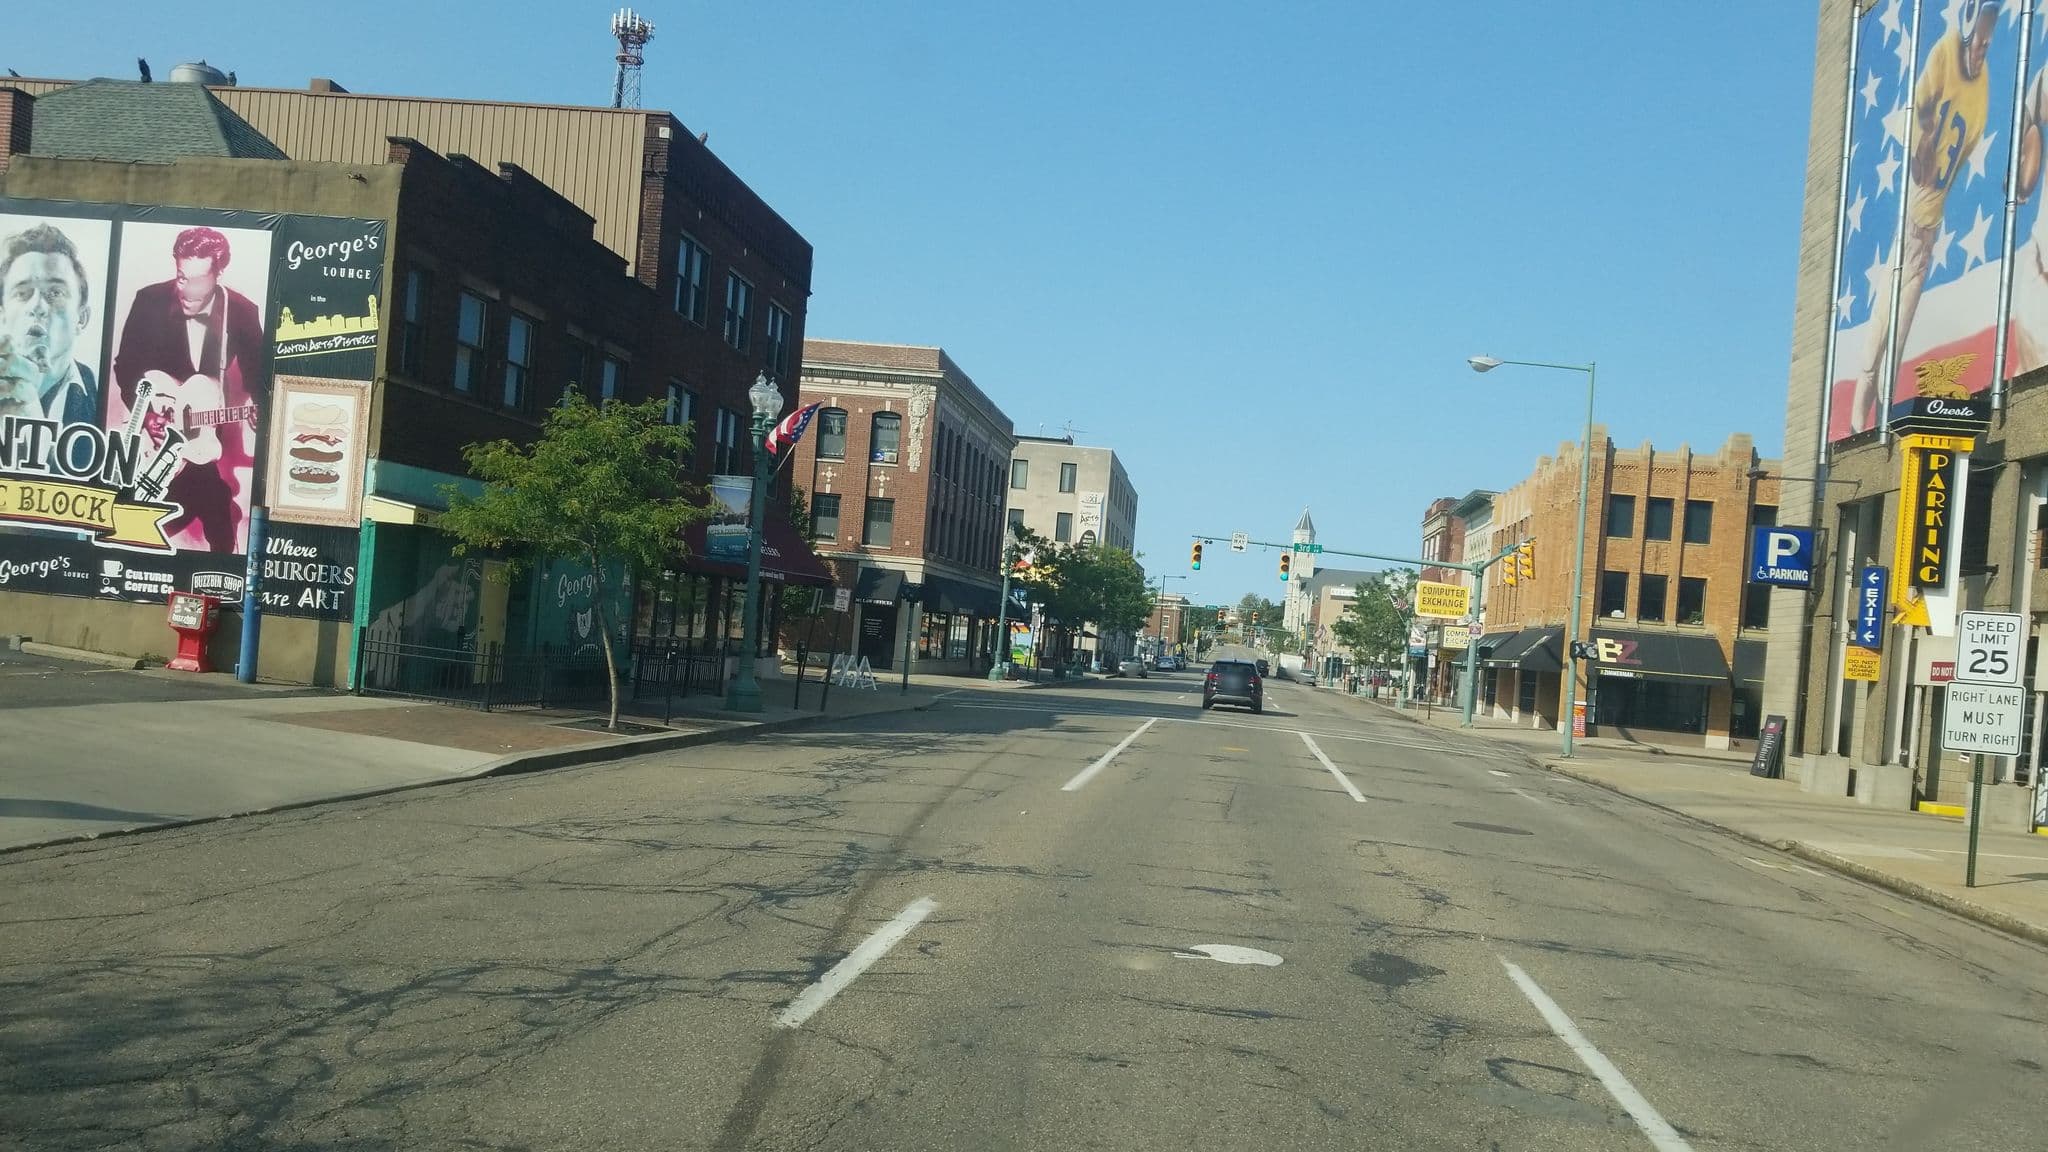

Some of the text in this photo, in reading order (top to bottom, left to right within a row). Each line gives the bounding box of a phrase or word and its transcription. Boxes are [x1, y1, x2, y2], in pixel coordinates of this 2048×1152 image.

[288, 235, 379, 270] George's
[323, 266, 371, 280] LOUNGE
[18, 486, 109, 523] BLOCK
[1919, 453, 1949, 584] PARKING
[265, 536, 318, 558] Where
[1298, 543, 1311, 553] 3rd
[1767, 532, 1801, 567] P
[0, 555, 71, 584] George's
[125, 568, 174, 584] CULTURED
[264, 559, 355, 586] BURGERS
[1769, 567, 1809, 582] PARKING
[124, 580, 159, 593] COFFEE
[194, 574, 242, 592] BUZZBIN SHOP
[557, 564, 607, 608] Georg's
[297, 587, 345, 610] ART
[1422, 586, 1466, 598] COMPUTER
[1421, 597, 1464, 608] EXCHANGE
[1864, 588, 1880, 627] EXIT
[1966, 620, 2016, 633] SPEED
[1970, 633, 2010, 646] LIMIT
[1969, 648, 2009, 675] 25
[1931, 666, 1953, 677] DO NOT
[1951, 690, 2019, 706] RIGHT LANE
[1963, 711, 2005, 727] MUST
[1947, 730, 2017, 746] TURN RIGHT
